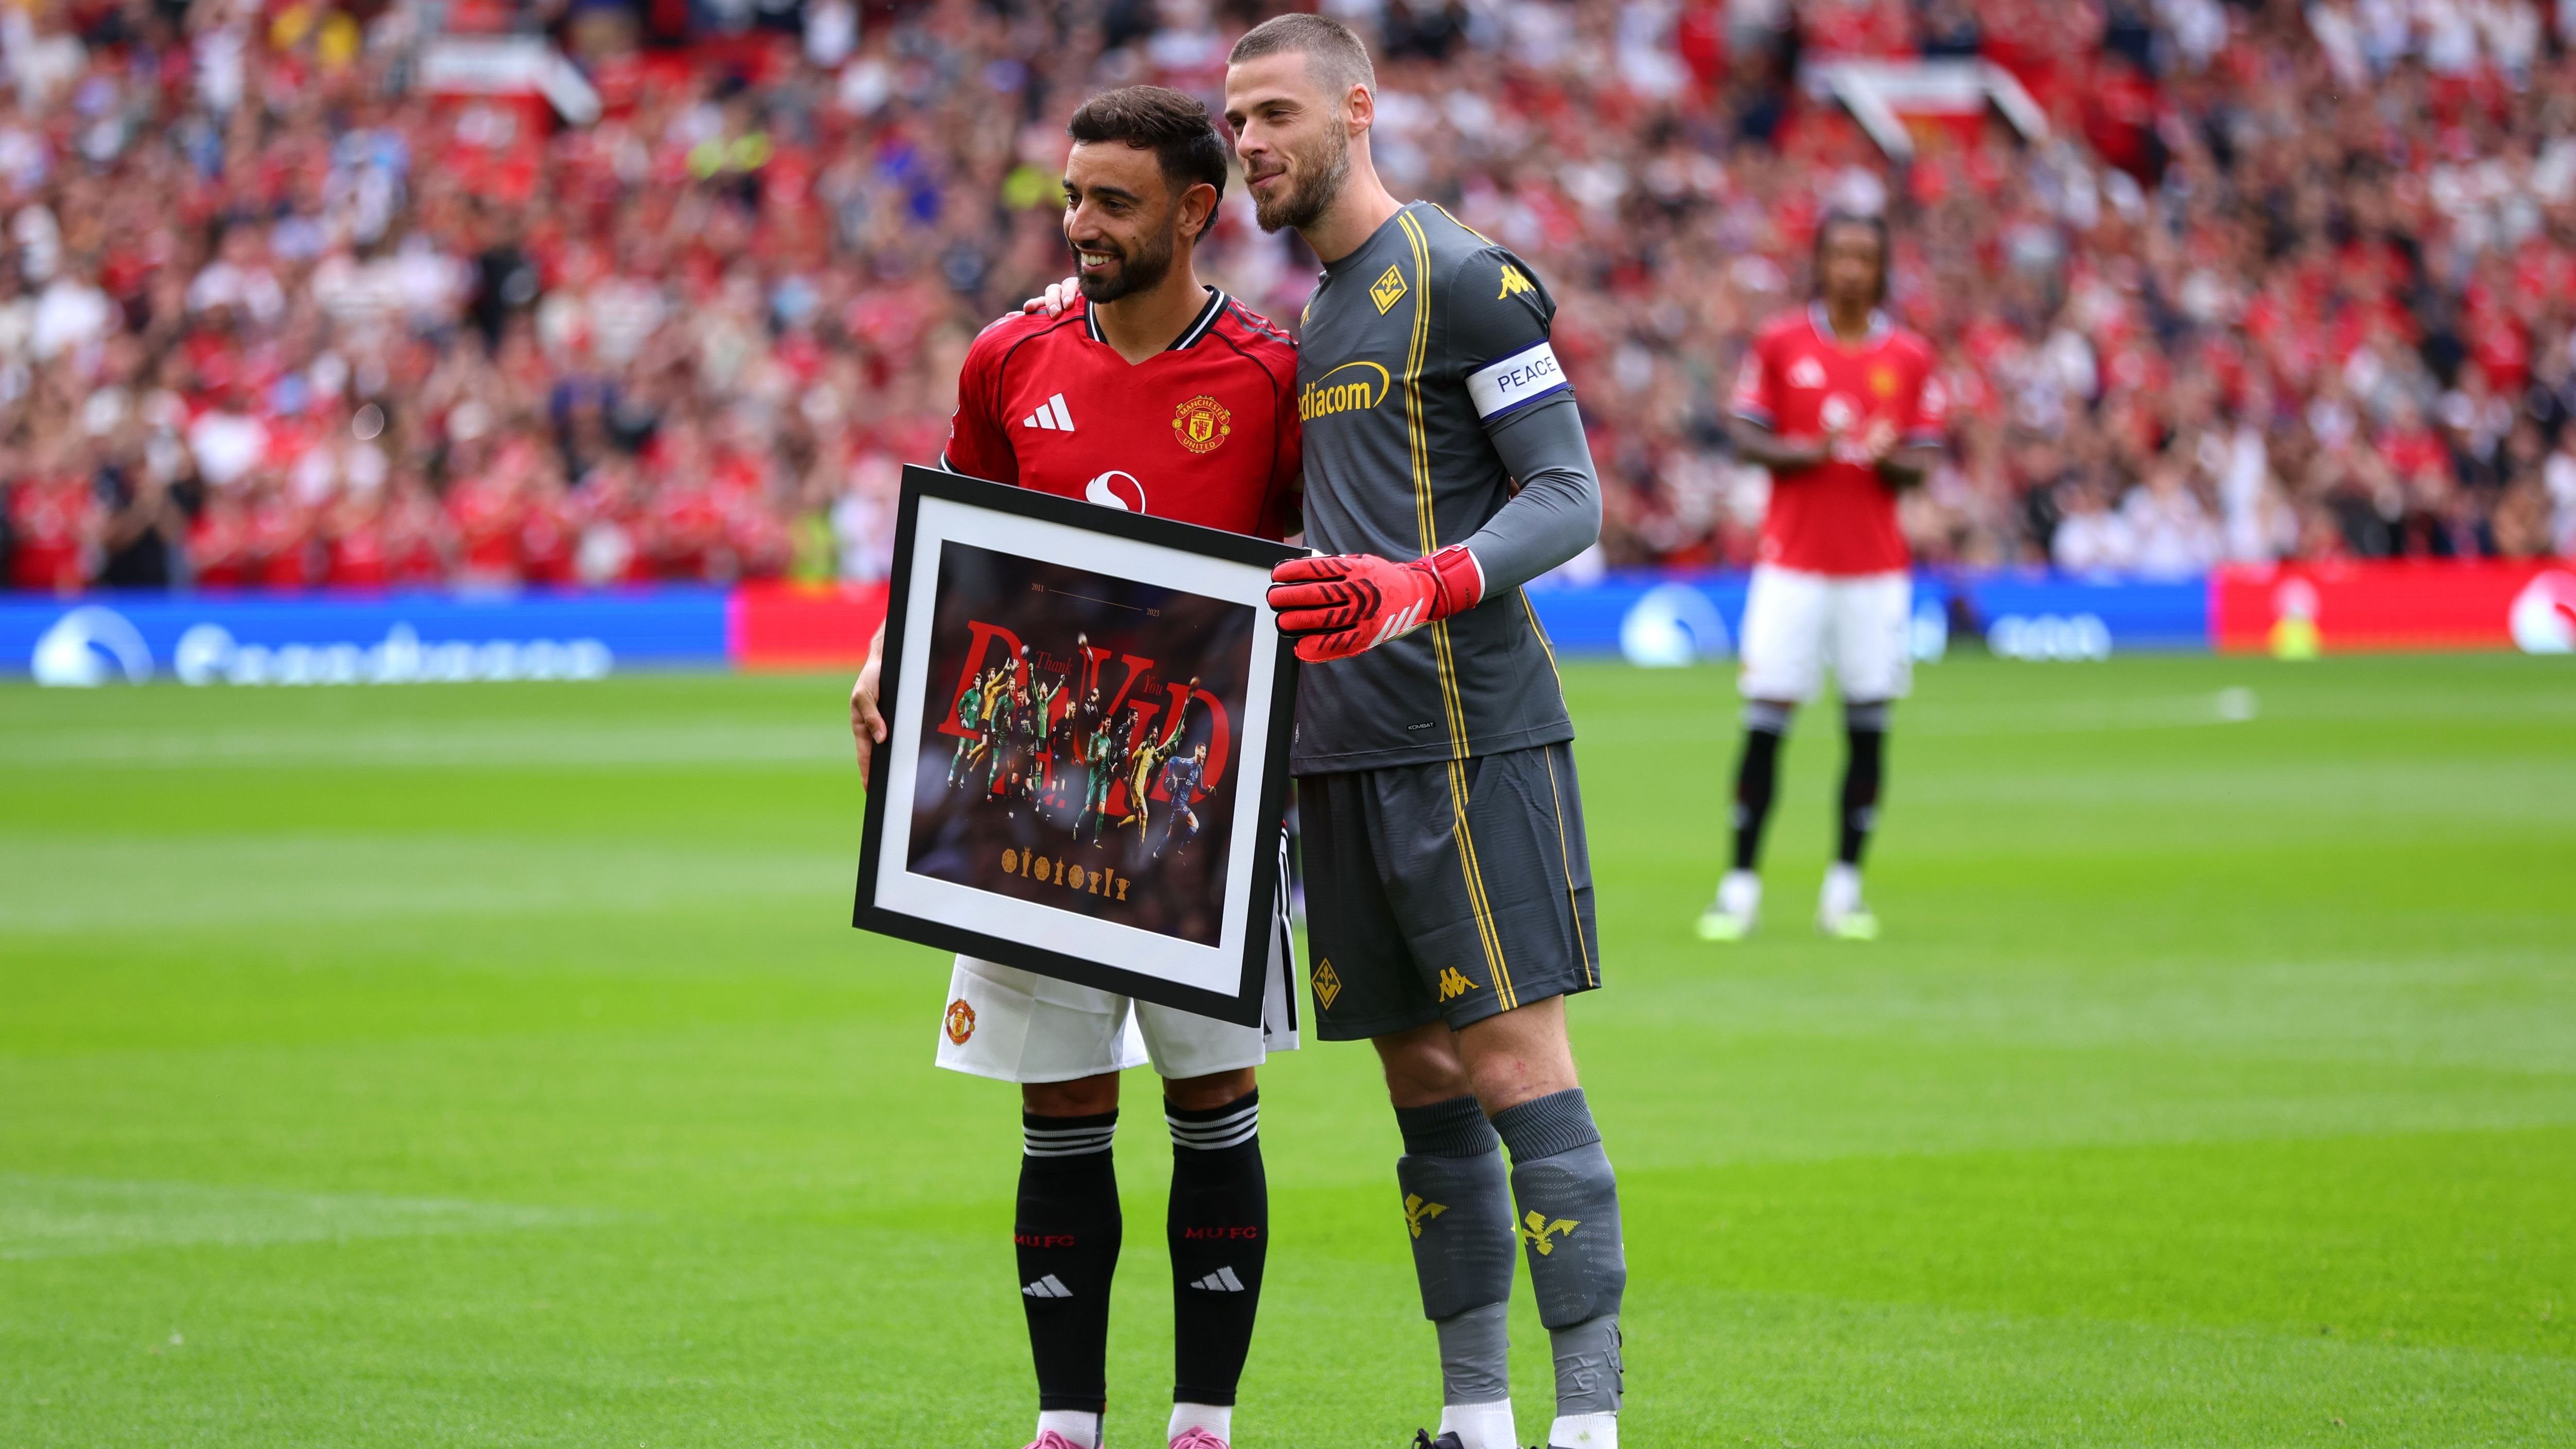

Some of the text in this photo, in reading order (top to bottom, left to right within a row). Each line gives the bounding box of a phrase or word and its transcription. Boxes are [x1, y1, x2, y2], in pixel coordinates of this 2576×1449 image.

[1497, 356, 1557, 393] PEACE
[1180, 399, 1227, 422] MANCHESTER
[1182, 437, 1216, 450] UNITED
[1031, 583, 1160, 617] 2011 2023
[1036, 650, 1163, 696] Thank You
